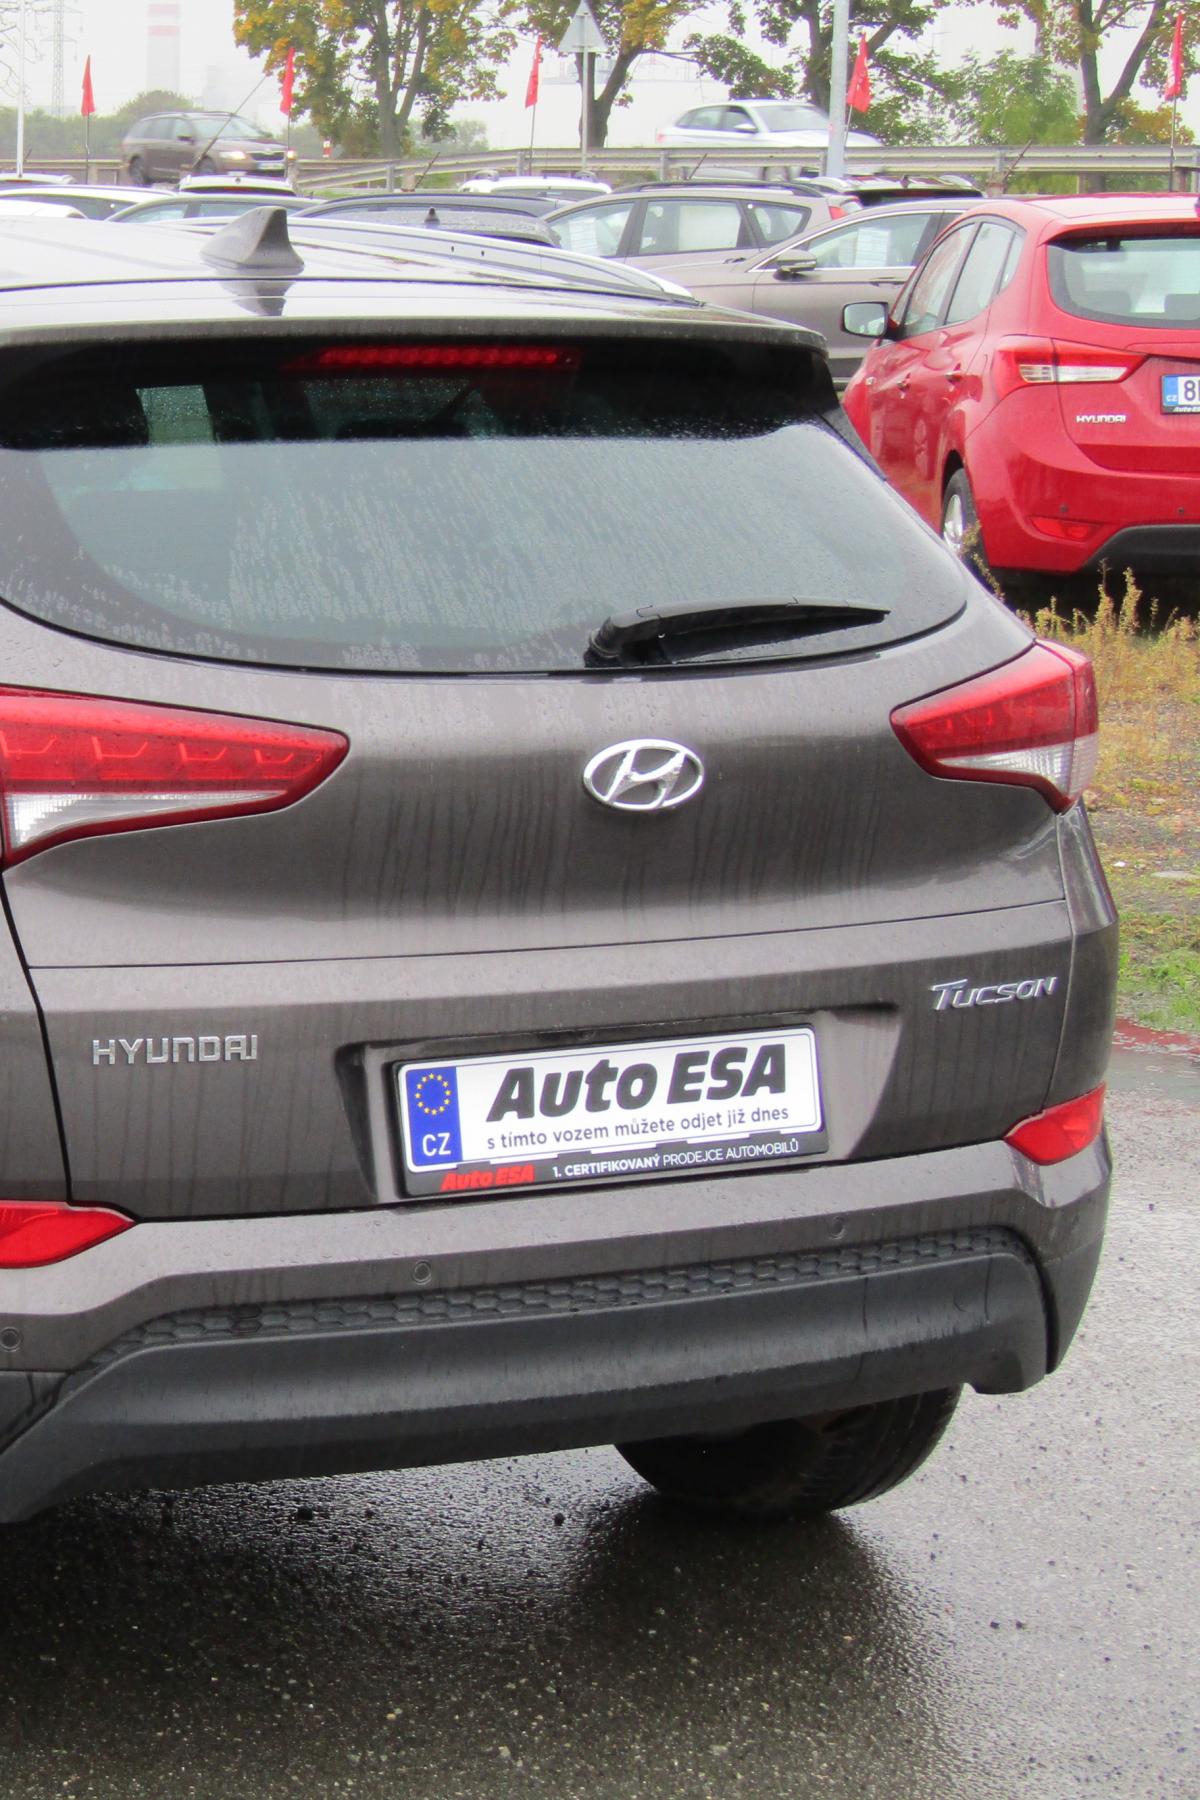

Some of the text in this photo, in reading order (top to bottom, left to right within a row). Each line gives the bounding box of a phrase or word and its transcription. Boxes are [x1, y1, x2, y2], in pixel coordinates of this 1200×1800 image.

[1184, 379, 1200, 401] 8
[1076, 415, 1126, 424] HYUNDAI
[92, 1034, 258, 1065] HYUNDAI
[486, 1044, 786, 1123] Auto ESA
[487, 1106, 788, 1149] s tímto vozem můžete odjet již dnes
[422, 1132, 452, 1157] CZ
[552, 1138, 799, 1177] 1. CERTIFIKOVANÝ PRODEJCE AUTOMOBILŮ
[440, 1164, 535, 1191] Auto ESA
